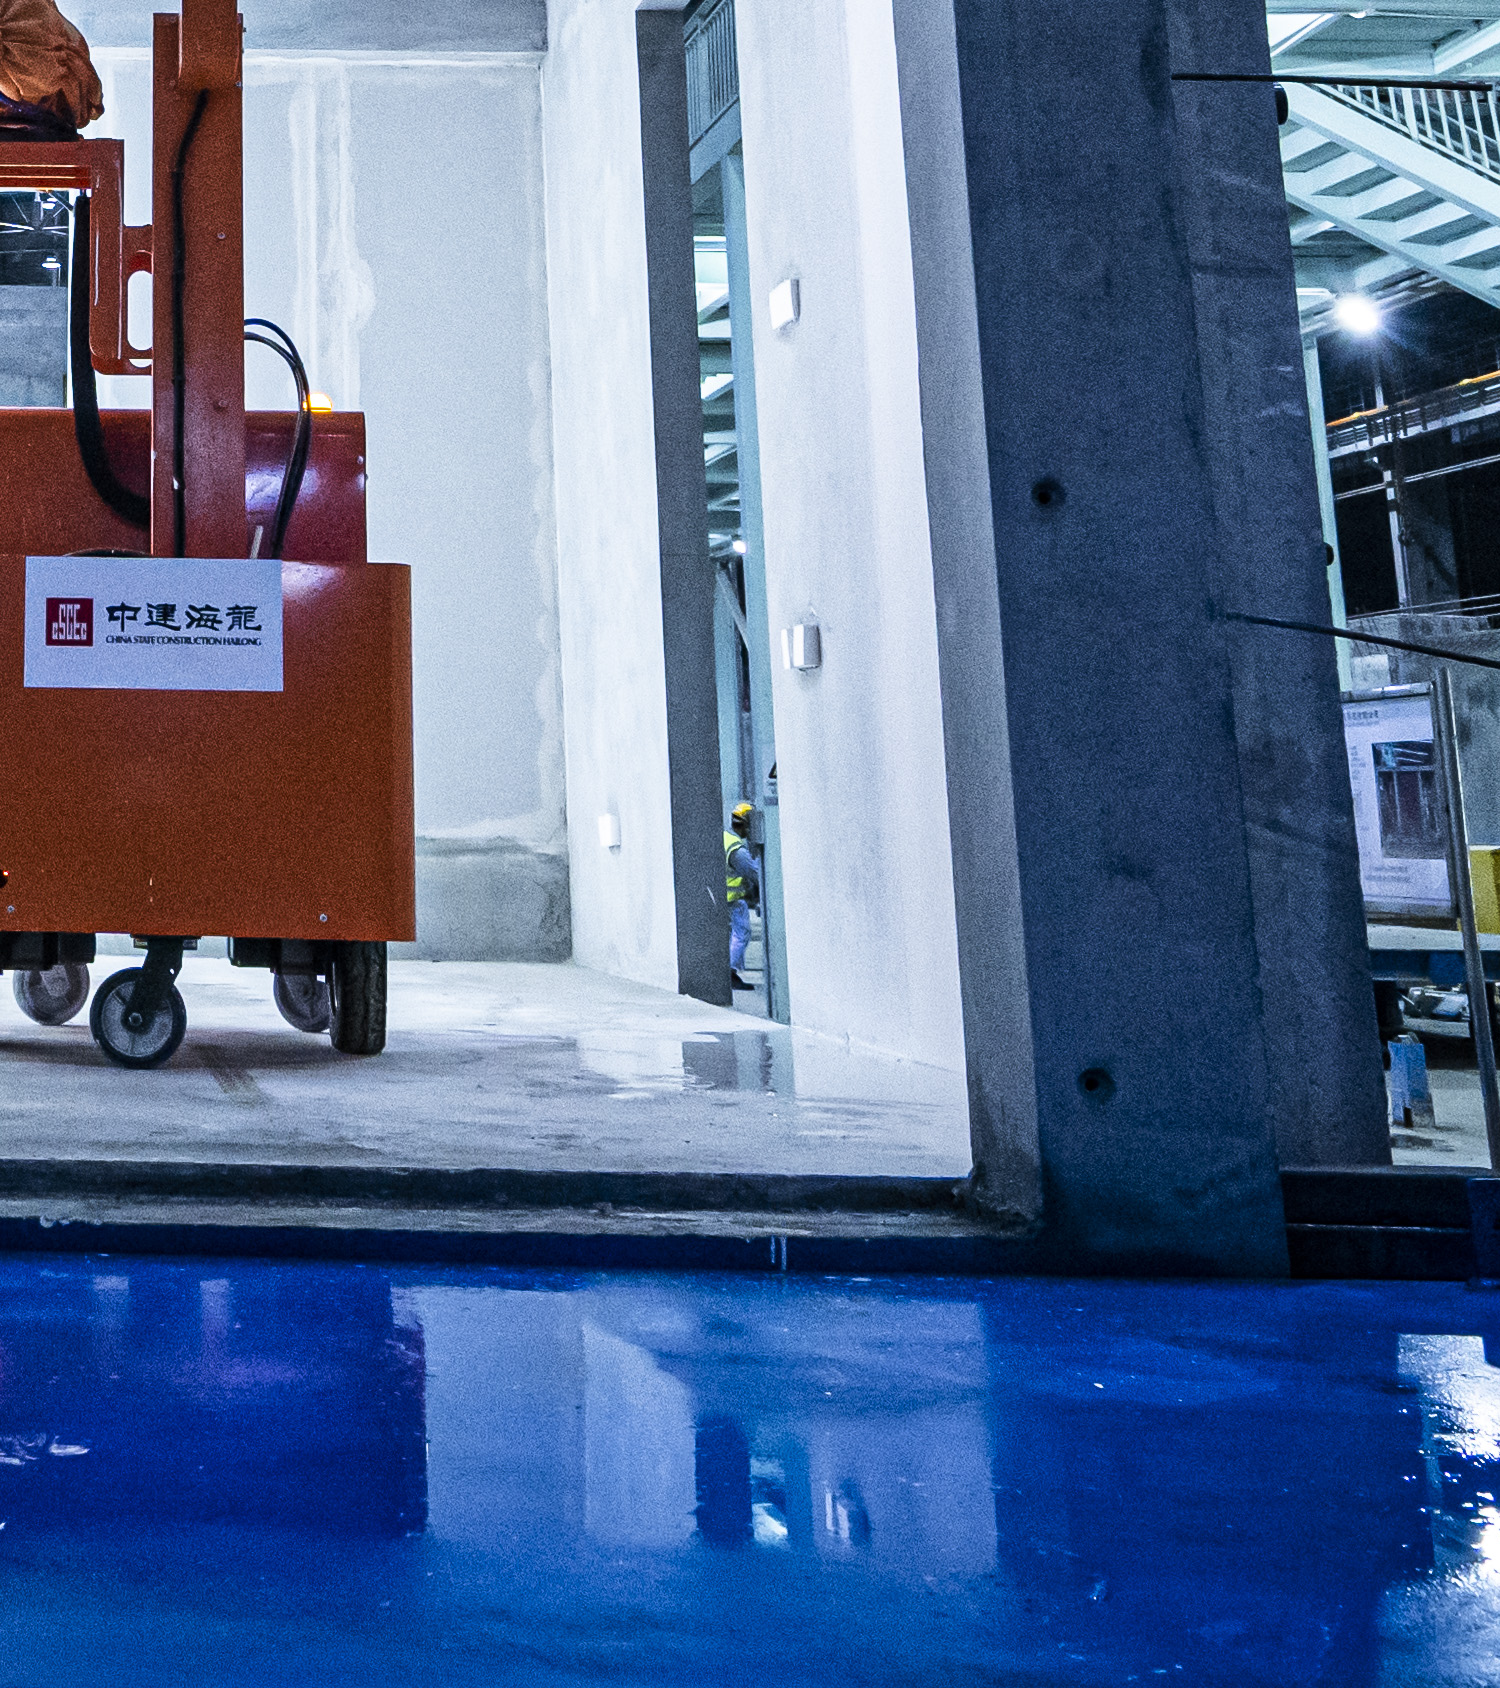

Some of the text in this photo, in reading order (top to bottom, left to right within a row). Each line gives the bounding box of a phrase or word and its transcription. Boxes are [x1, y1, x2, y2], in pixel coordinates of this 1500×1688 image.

[105, 635, 262, 646] CHINA STATE CONSTRUCTION HAILONG
